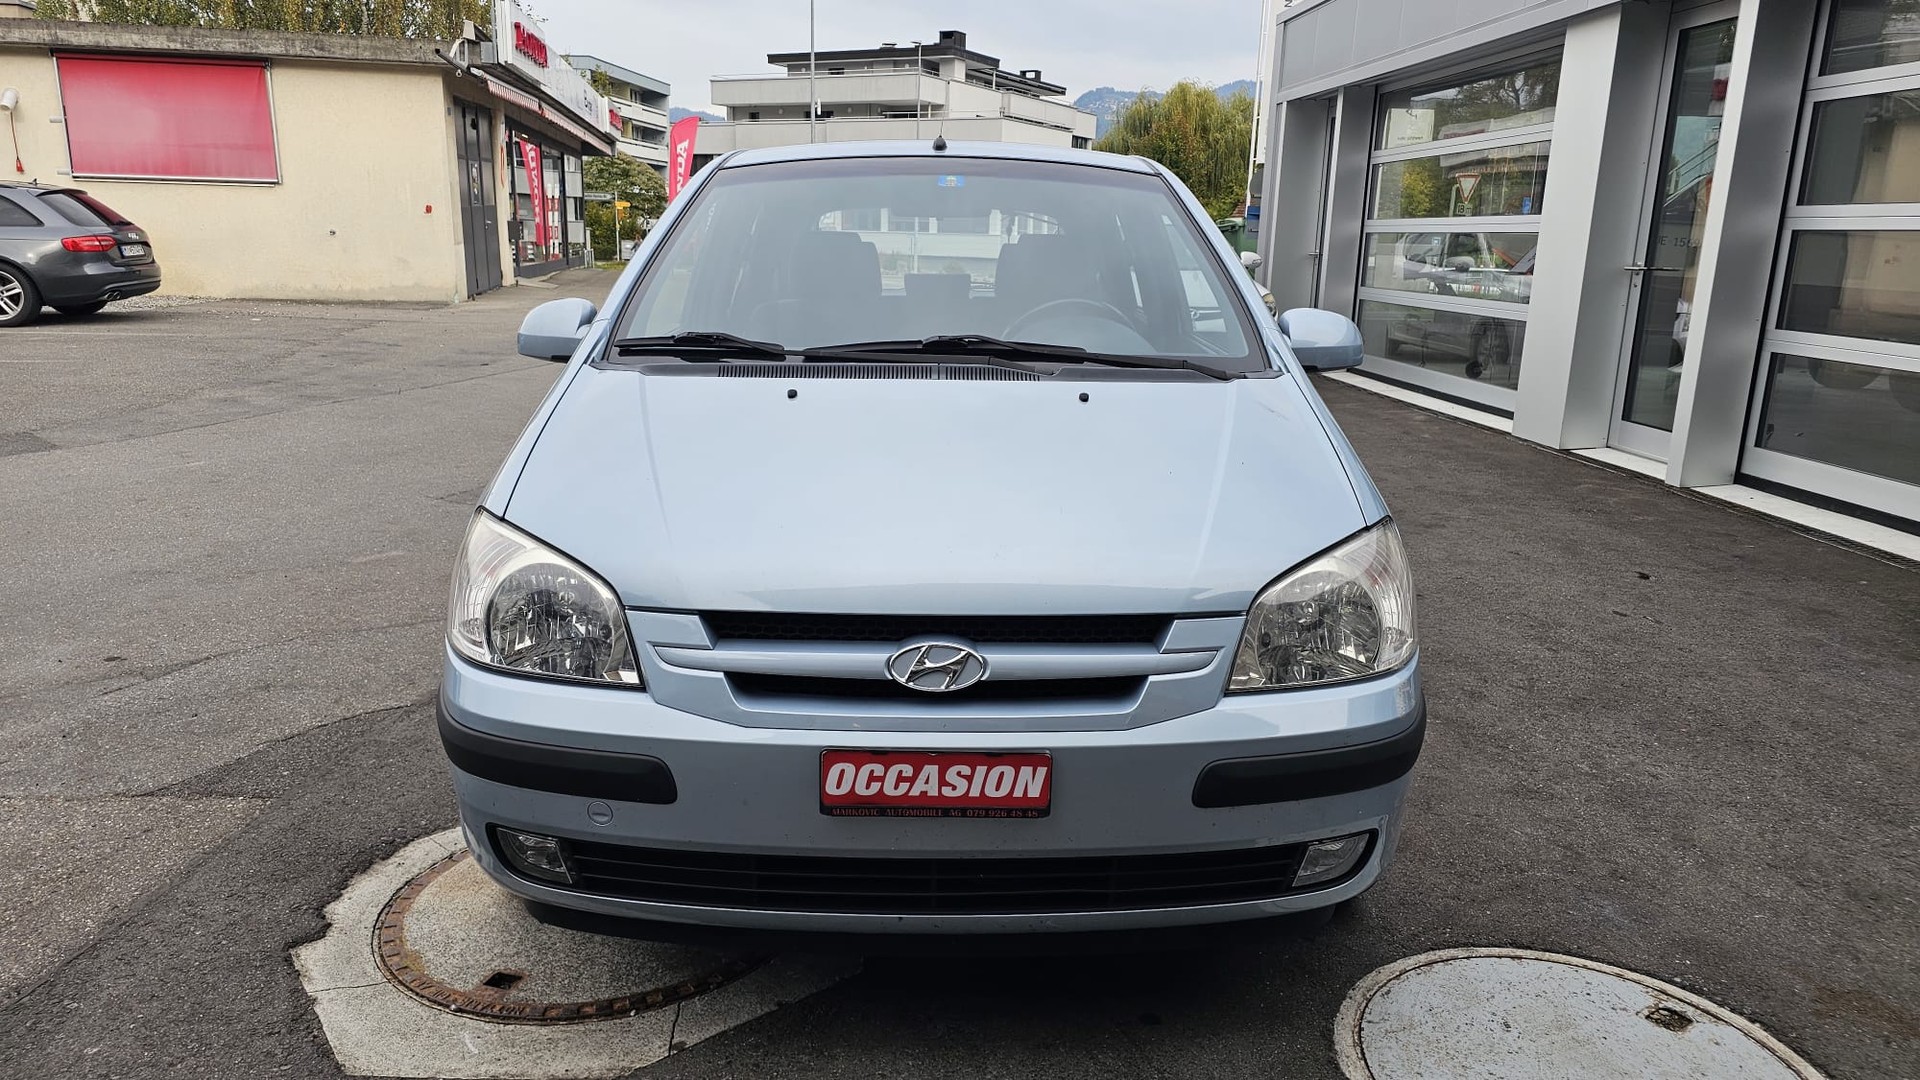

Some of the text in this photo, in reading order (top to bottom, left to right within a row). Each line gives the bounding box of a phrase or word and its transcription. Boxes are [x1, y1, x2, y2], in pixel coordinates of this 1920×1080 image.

[825, 762, 1048, 798] OCCASION
[831, 808, 880, 816] MARKOVIC
[885, 808, 944, 817] AUTOMOBILE
[948, 809, 961, 817] AG
[967, 809, 985, 817] 079
[988, 809, 1007, 817] 926
